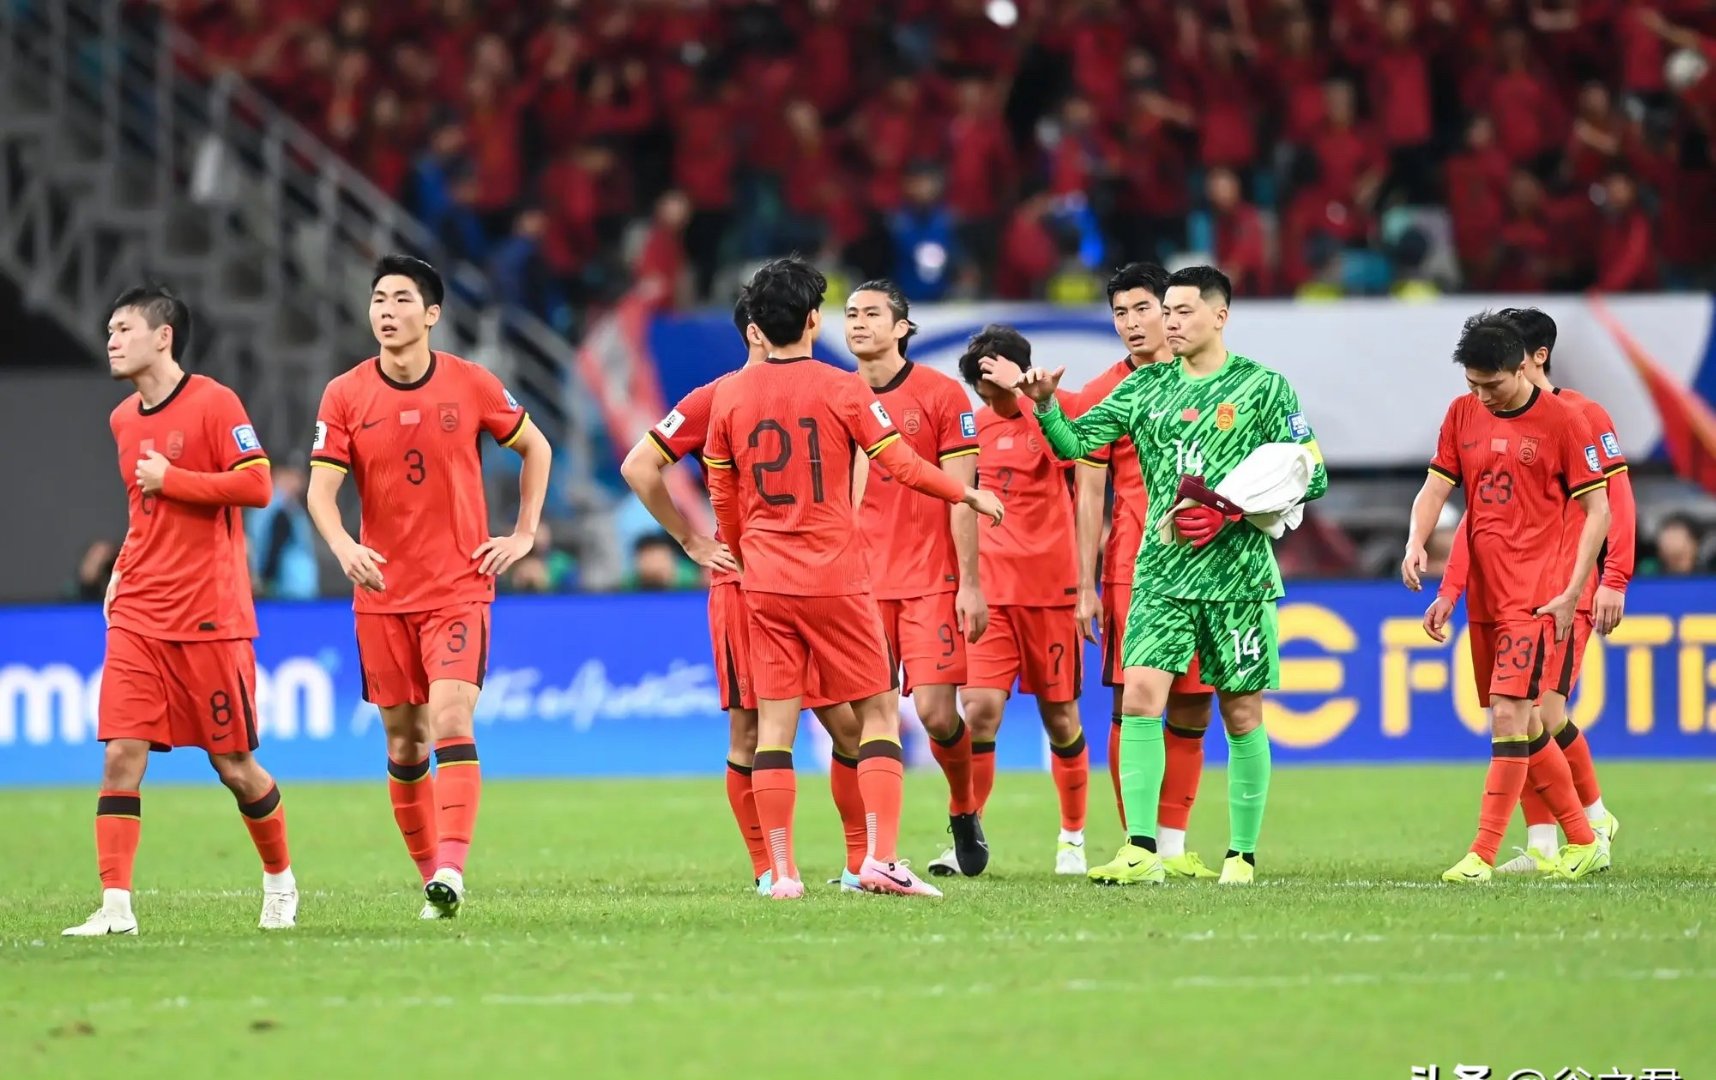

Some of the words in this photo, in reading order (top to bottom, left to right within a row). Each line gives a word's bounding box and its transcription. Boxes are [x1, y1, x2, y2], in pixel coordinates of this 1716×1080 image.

[404, 447, 426, 486] 3
[748, 417, 824, 506] 21
[1173, 439, 1205, 476] 14
[1480, 469, 1513, 504] 23
[447, 620, 468, 654] 3
[938, 623, 955, 657] 9
[1229, 626, 1261, 665] 14
[1496, 633, 1533, 670] 23
[1048, 642, 1065, 676] 7
[210, 689, 232, 727] 8
